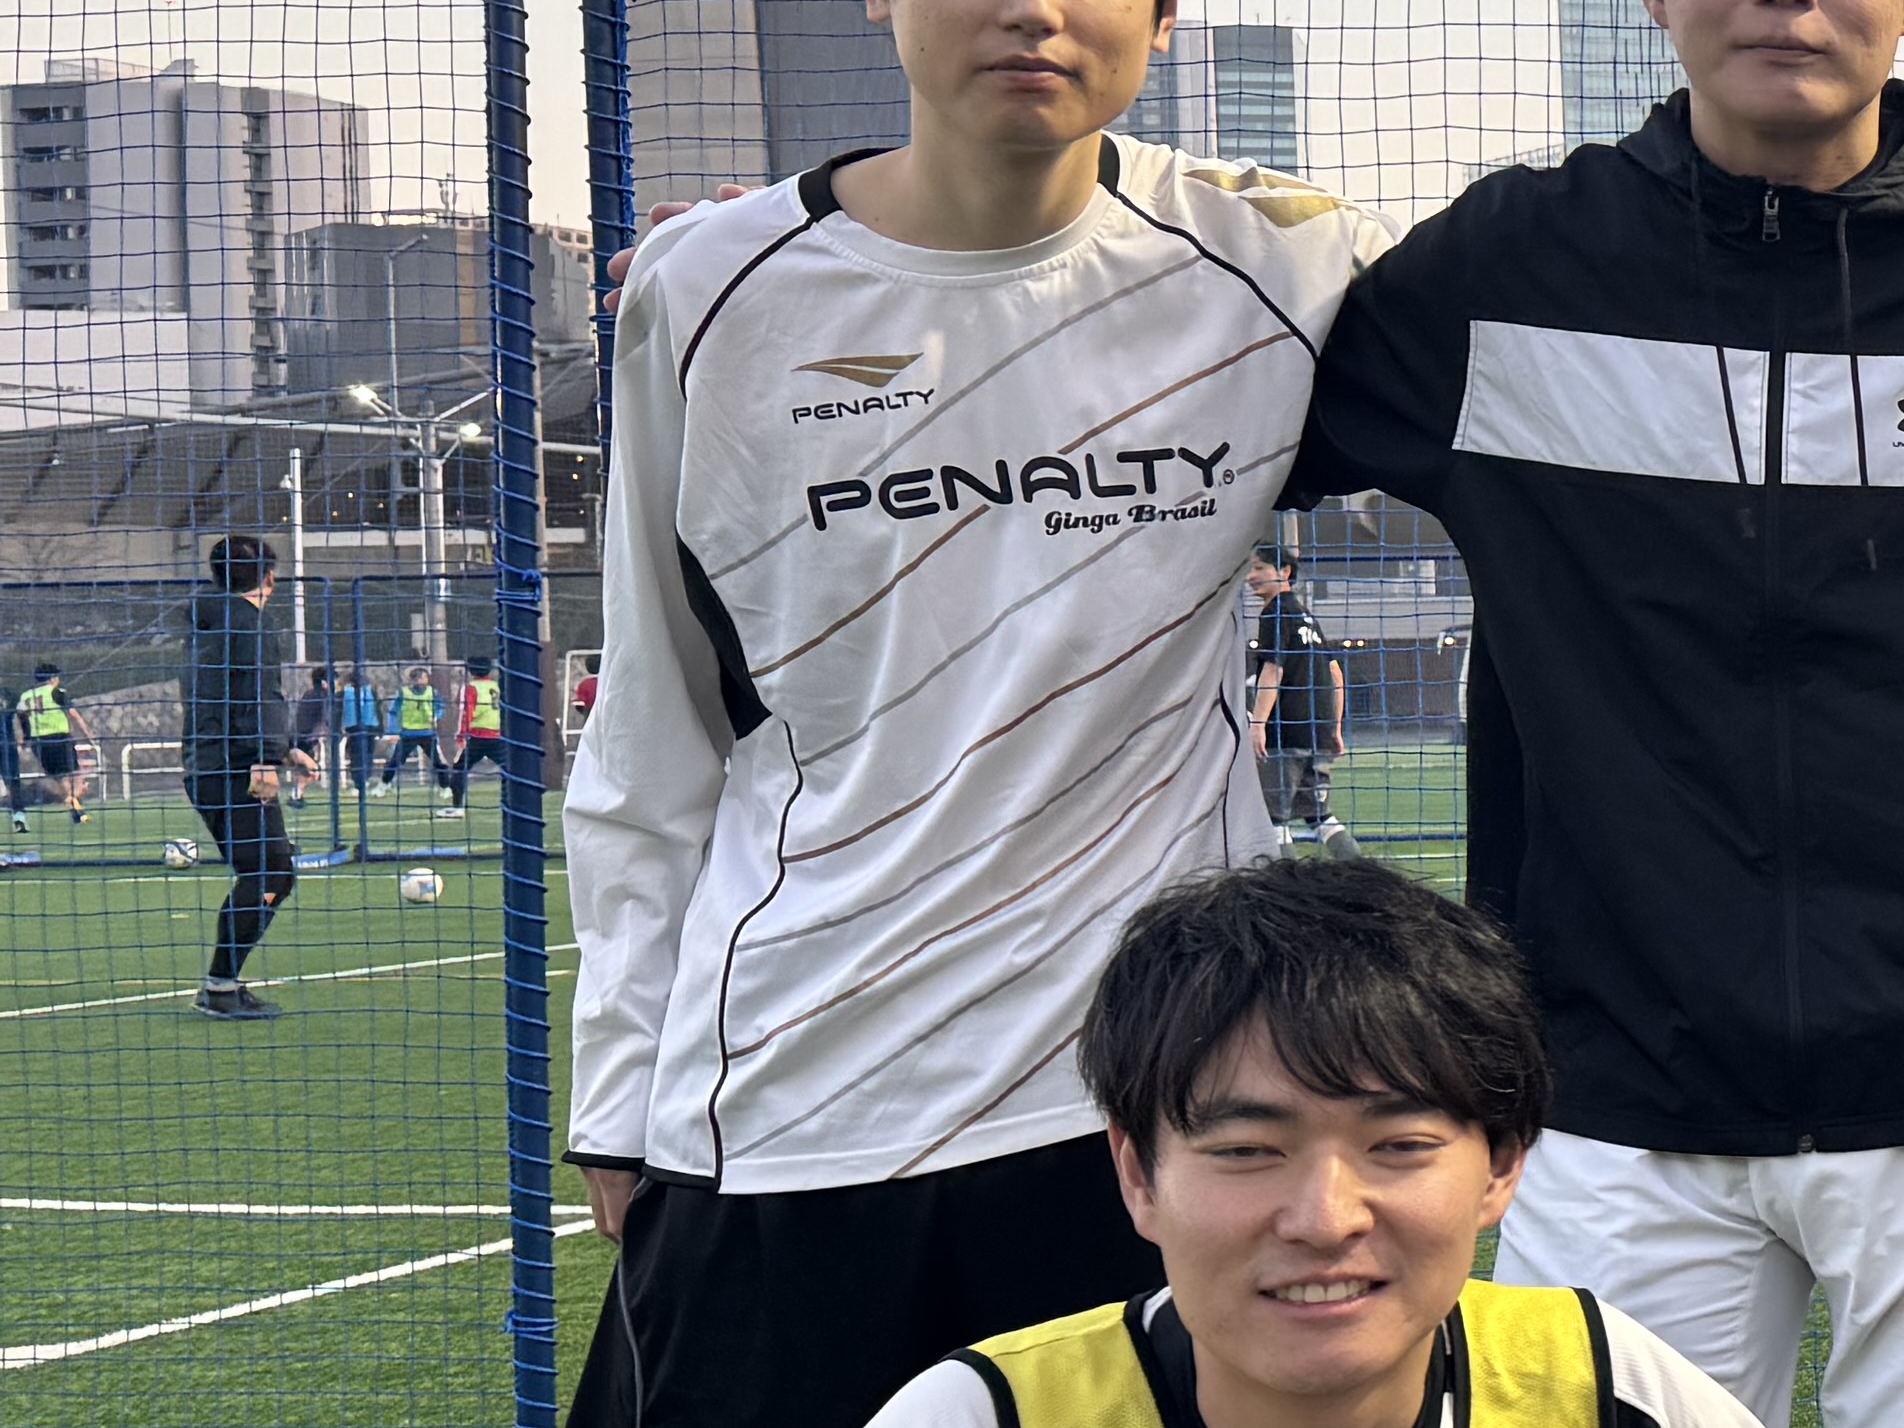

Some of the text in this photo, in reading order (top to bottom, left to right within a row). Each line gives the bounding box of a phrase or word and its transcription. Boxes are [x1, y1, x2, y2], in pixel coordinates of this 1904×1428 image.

[792, 388, 935, 424] PENALTY
[807, 441, 1230, 531] PENALTY
[1044, 498, 1219, 536] Ginga Brasil
